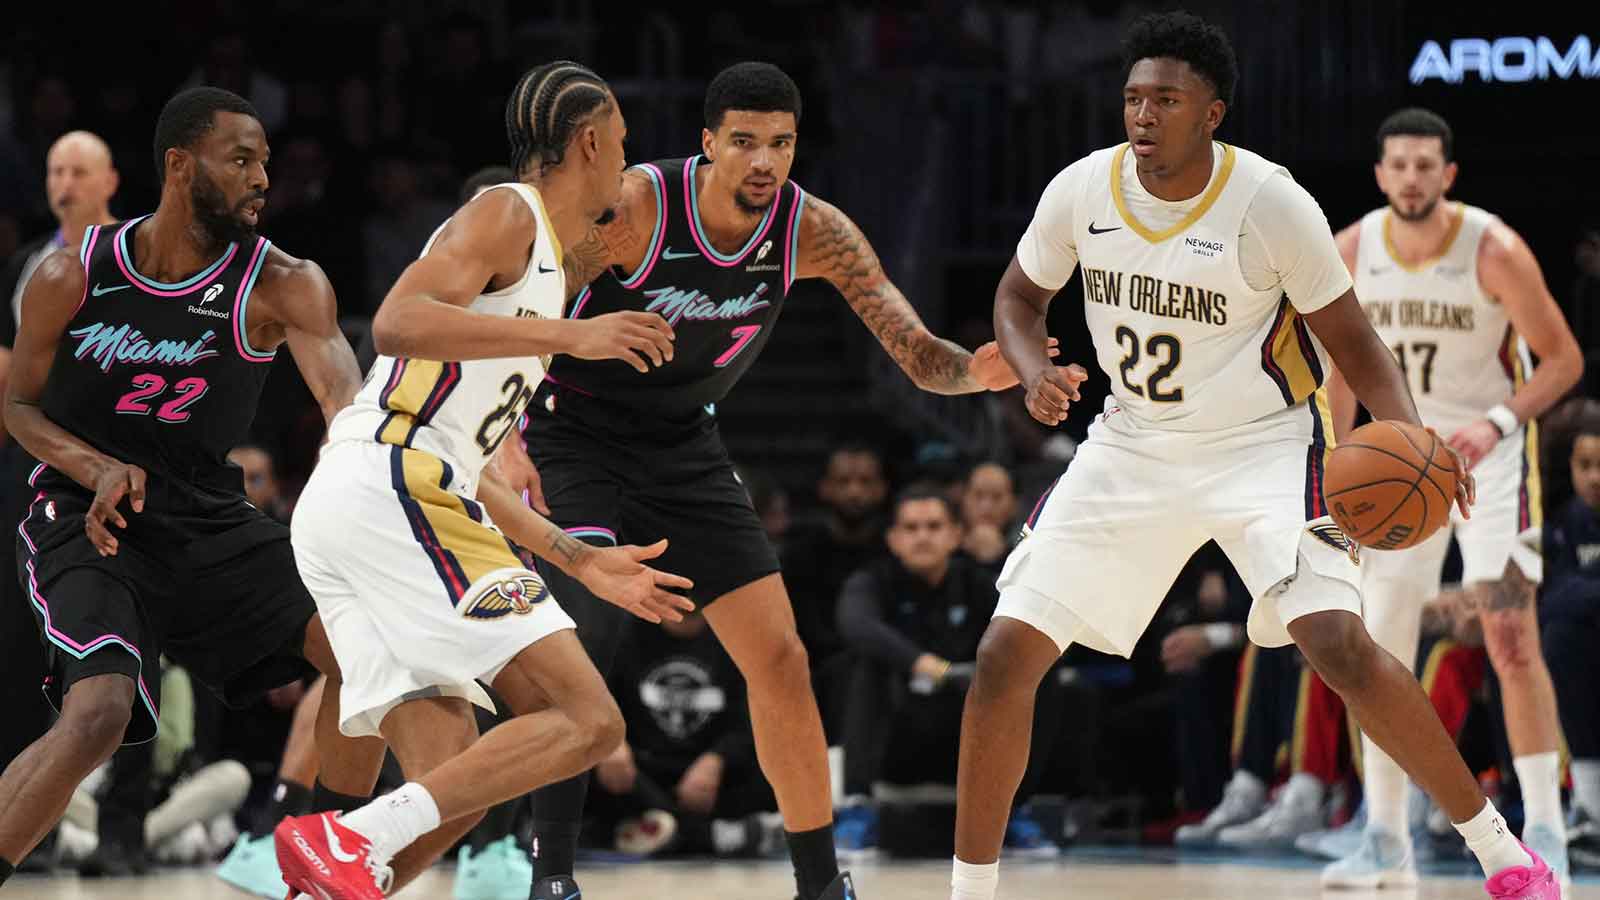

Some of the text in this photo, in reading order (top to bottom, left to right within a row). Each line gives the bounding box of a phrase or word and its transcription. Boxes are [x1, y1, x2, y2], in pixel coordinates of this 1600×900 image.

[1409, 34, 1600, 85] AROM
[1185, 237, 1224, 252] NEWAGE
[188, 305, 230, 319] Robinhood
[643, 282, 770, 327] Miami
[1083, 267, 1227, 326] NEW ORLEANS
[1399, 299, 1475, 333] ORLEANS
[70, 322, 219, 374] Miami
[713, 324, 762, 367] 7
[1115, 323, 1184, 402] 22
[115, 373, 208, 423] 22
